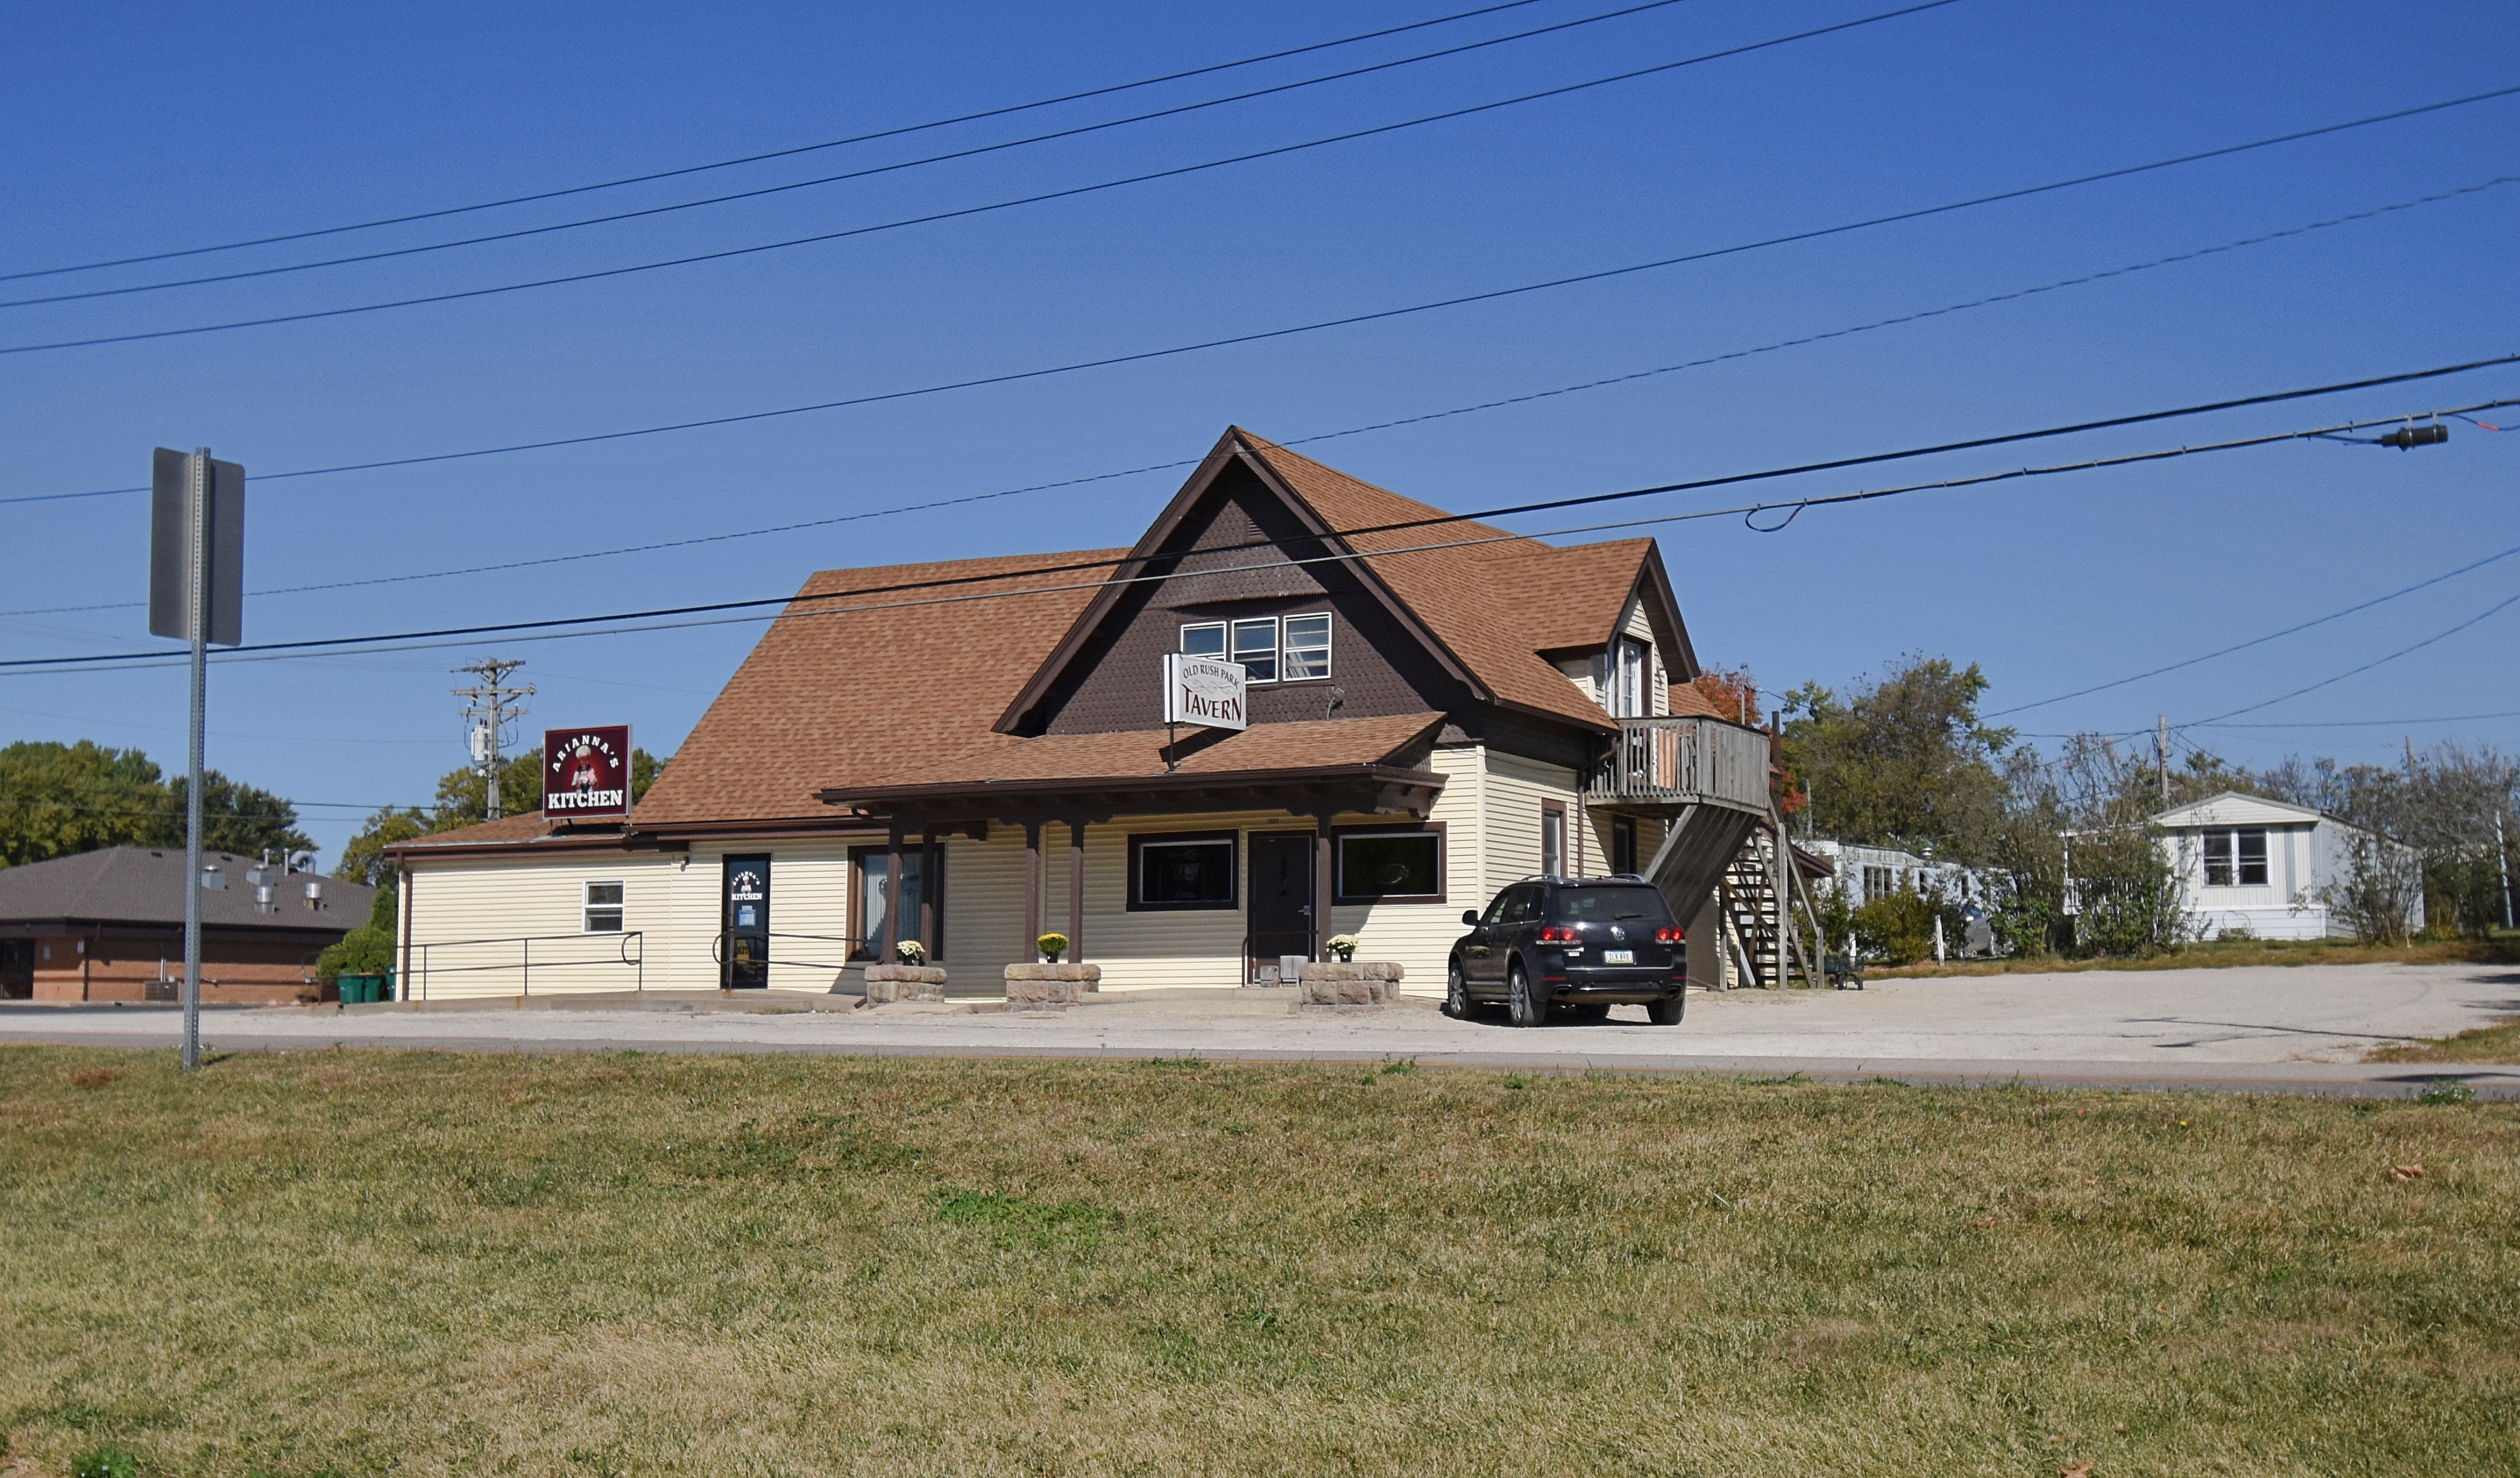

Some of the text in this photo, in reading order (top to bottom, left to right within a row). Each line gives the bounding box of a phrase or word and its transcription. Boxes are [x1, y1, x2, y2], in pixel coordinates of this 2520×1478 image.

[1183, 664, 1240, 690] OLD RUSH PARK
[1181, 684, 1242, 722] TAVERN
[553, 735, 619, 772] ARIANNA'S
[548, 790, 623, 810] KITCHEN
[731, 893, 762, 901] KITCHEN
